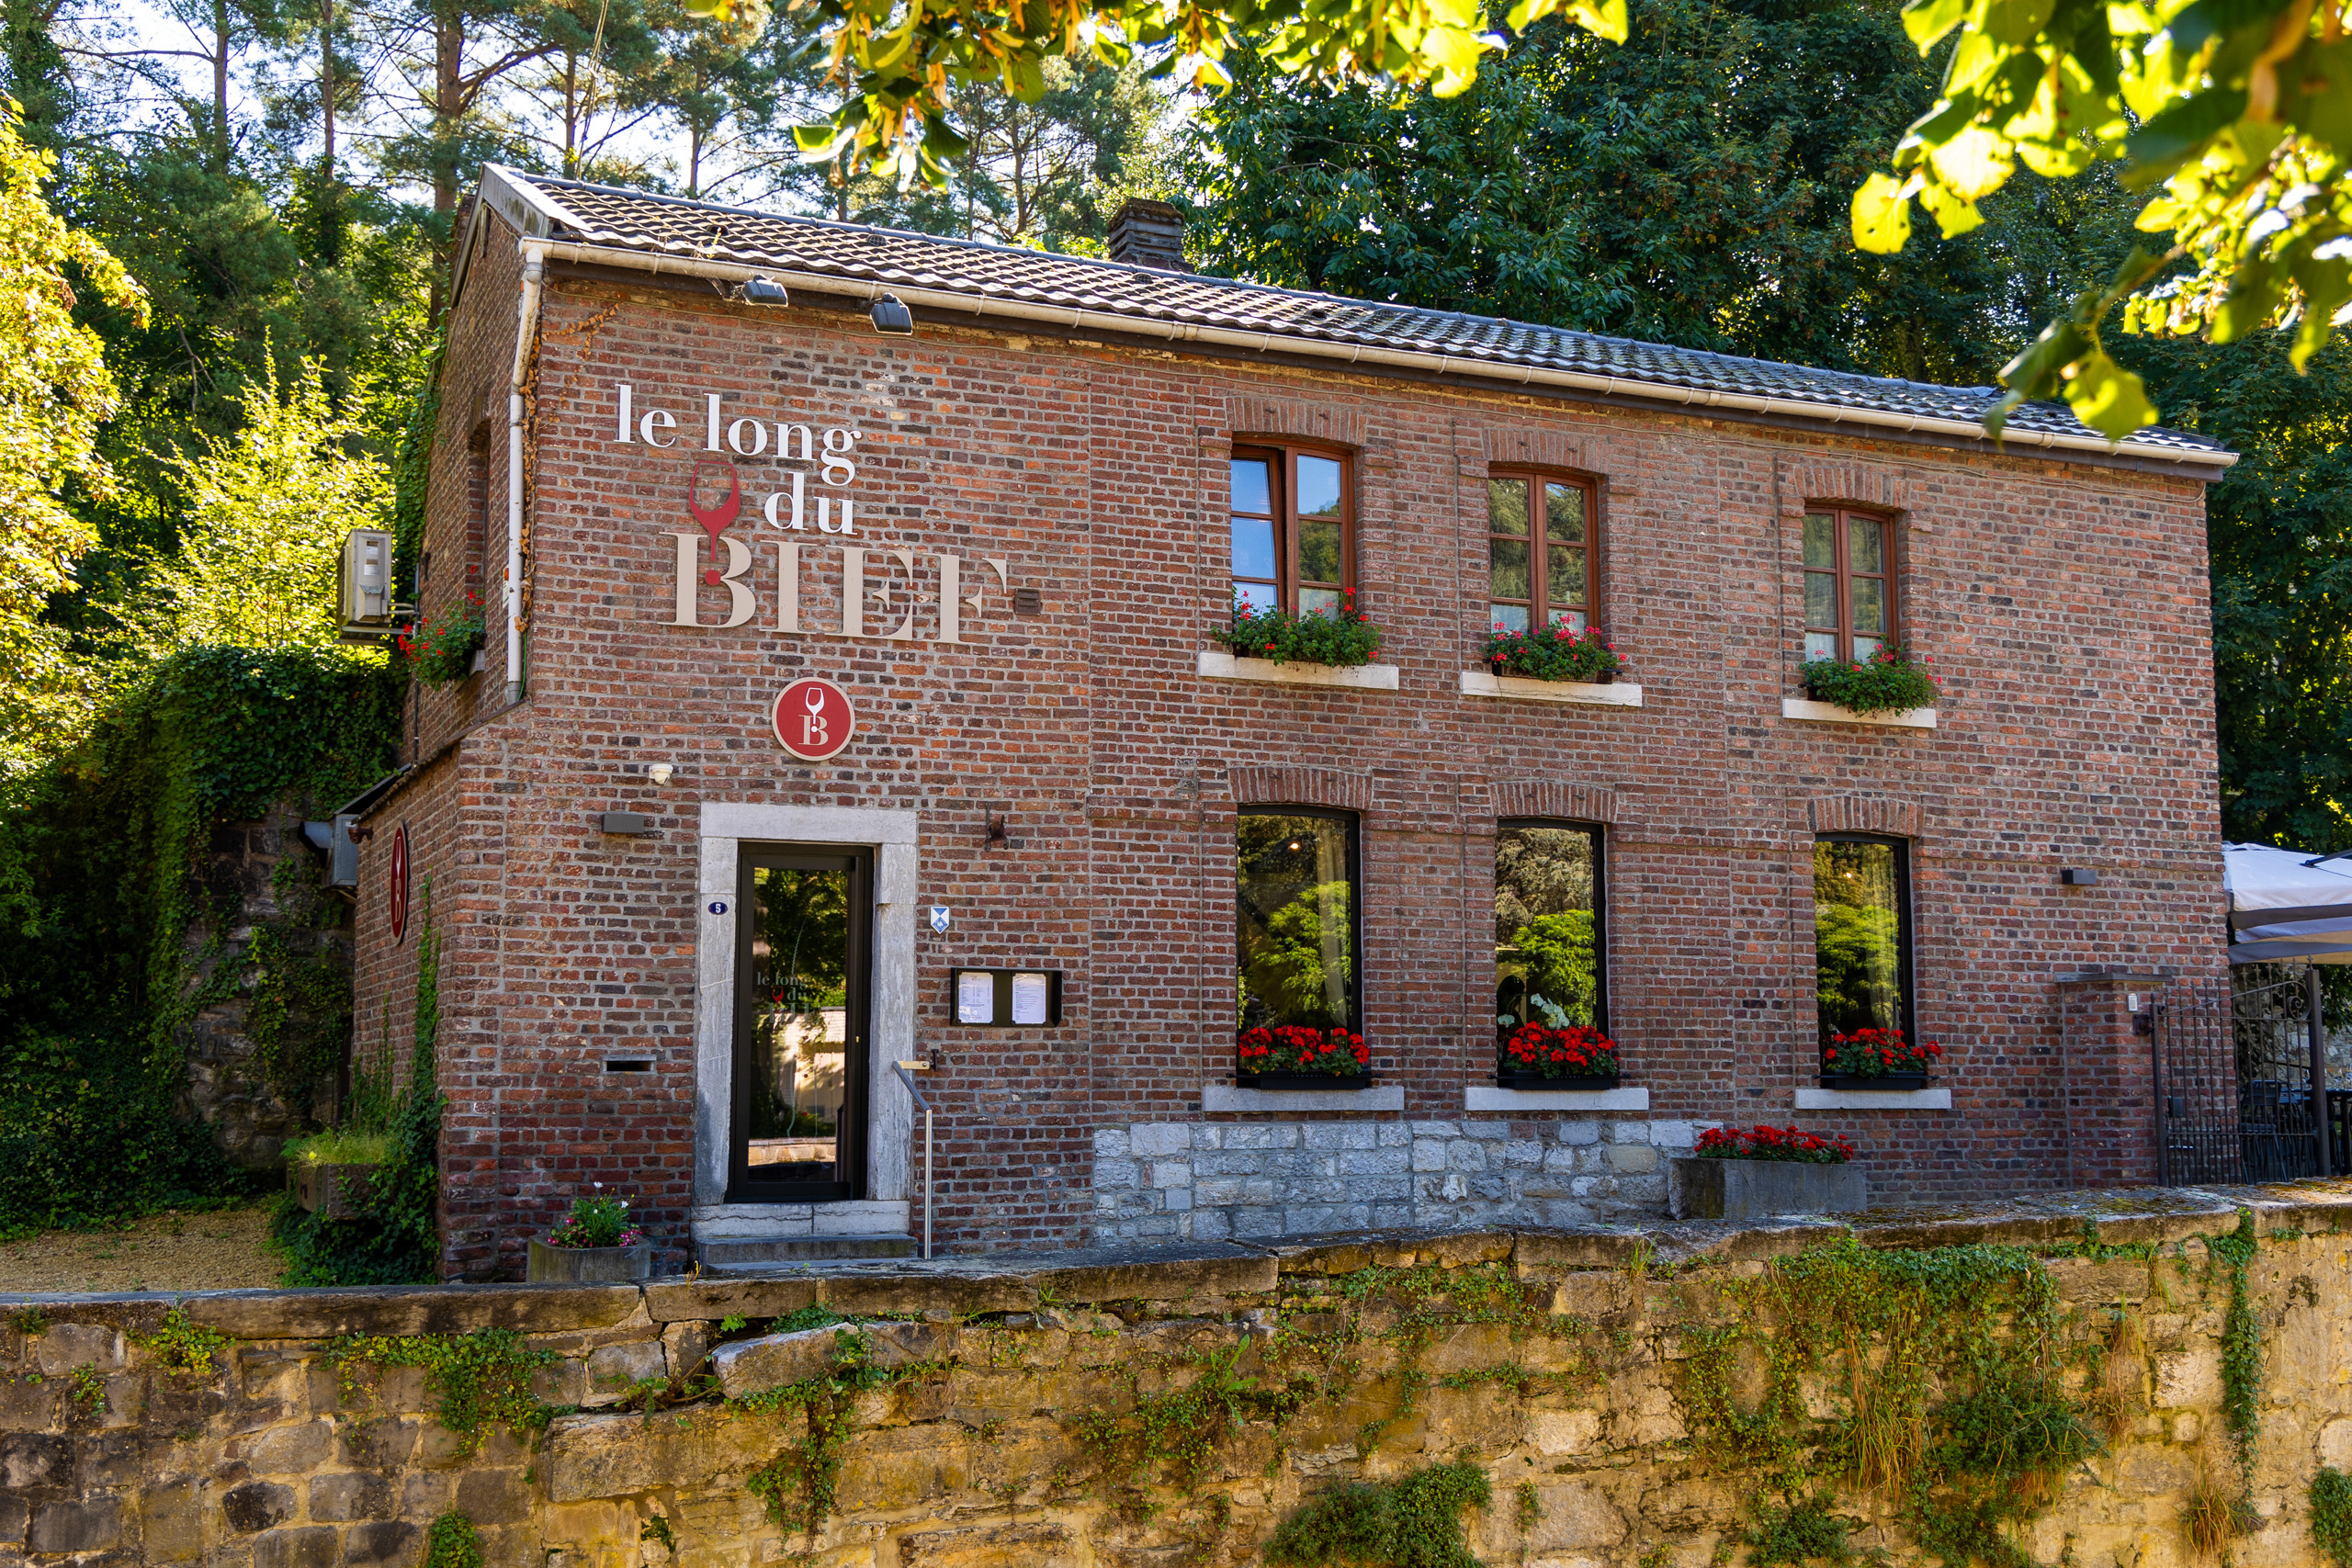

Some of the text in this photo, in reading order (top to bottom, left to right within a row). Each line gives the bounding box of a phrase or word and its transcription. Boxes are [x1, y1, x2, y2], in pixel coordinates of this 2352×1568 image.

[613, 383, 863, 487] le long
[763, 470, 858, 536] du
[656, 530, 1008, 645] BIEF
[715, 903, 722, 914] 5
[756, 971, 808, 991] le long
[786, 987, 808, 1001] du
